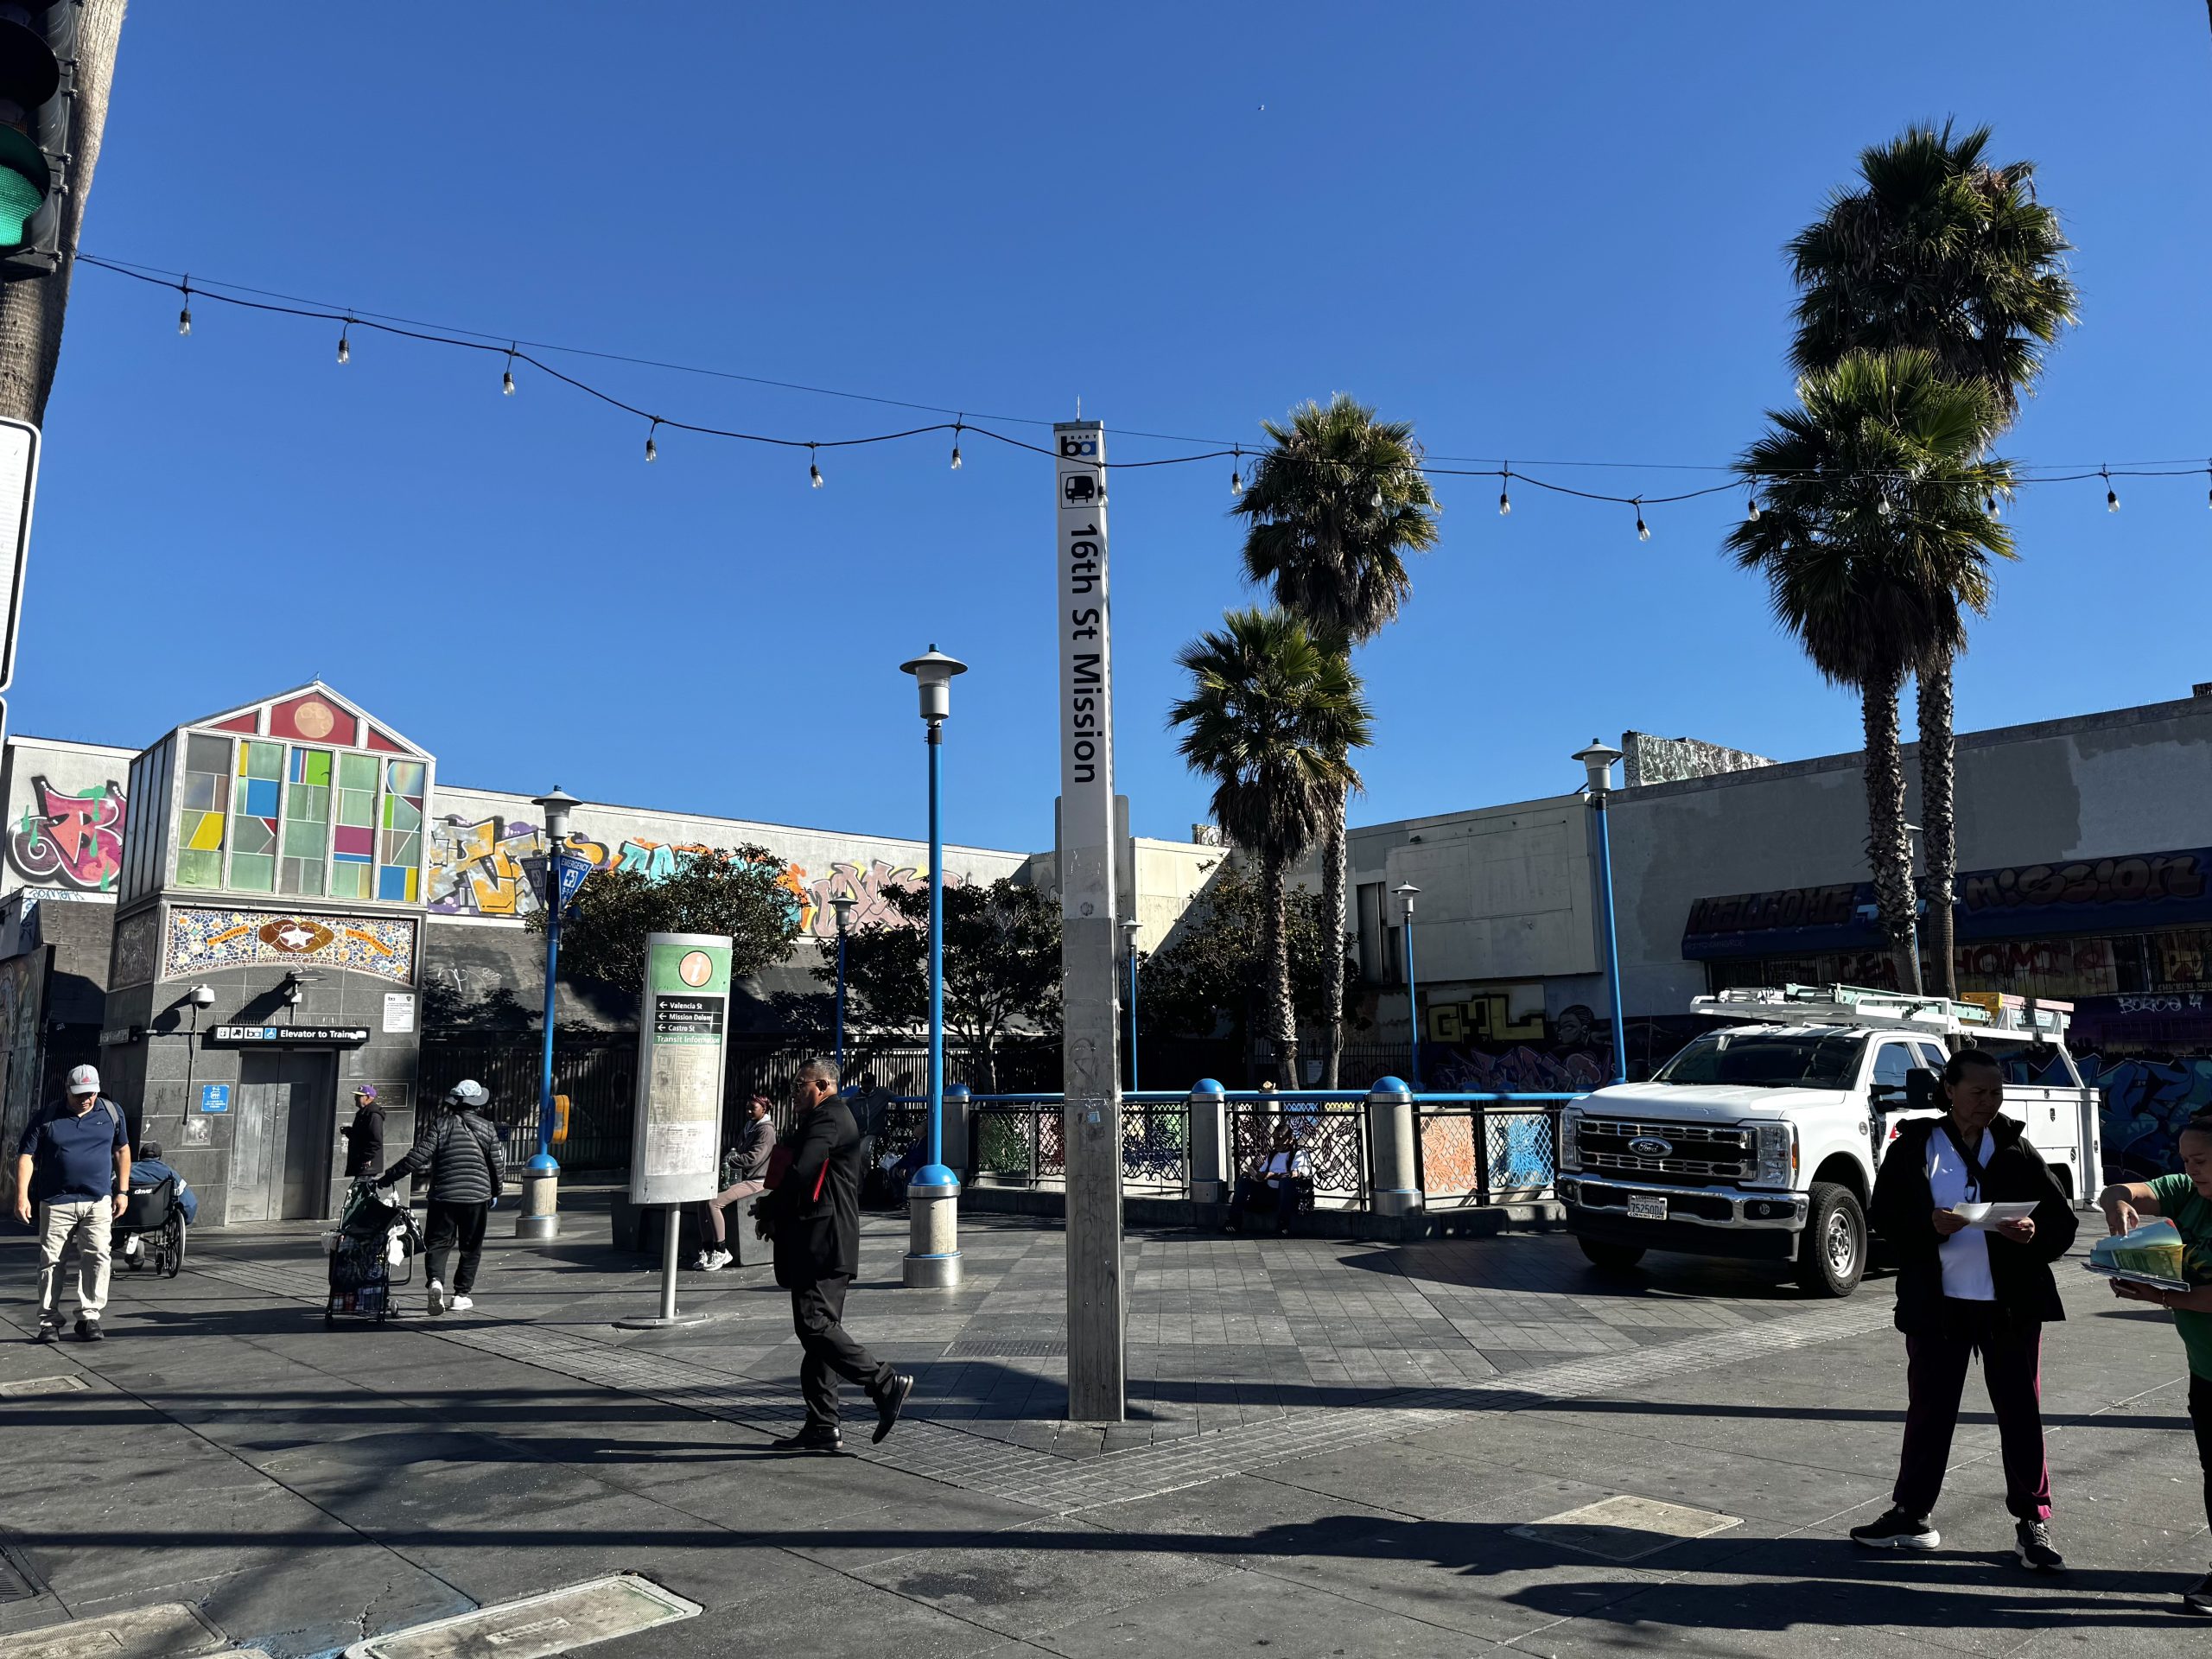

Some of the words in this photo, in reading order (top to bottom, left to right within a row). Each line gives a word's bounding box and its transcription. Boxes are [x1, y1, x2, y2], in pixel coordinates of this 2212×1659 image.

[1071, 523, 1101, 594] 16th
[1071, 608, 1100, 641] St
[1072, 653, 1103, 783] Mission
[561, 857, 589, 872] EMERGENCY
[561, 887, 574, 896] 9-1-1
[1685, 883, 1855, 934] WELCOME
[280, 1029, 316, 1038] Elevator
[329, 1030, 355, 1039] Train
[1638, 1142, 1659, 1153] Ford
